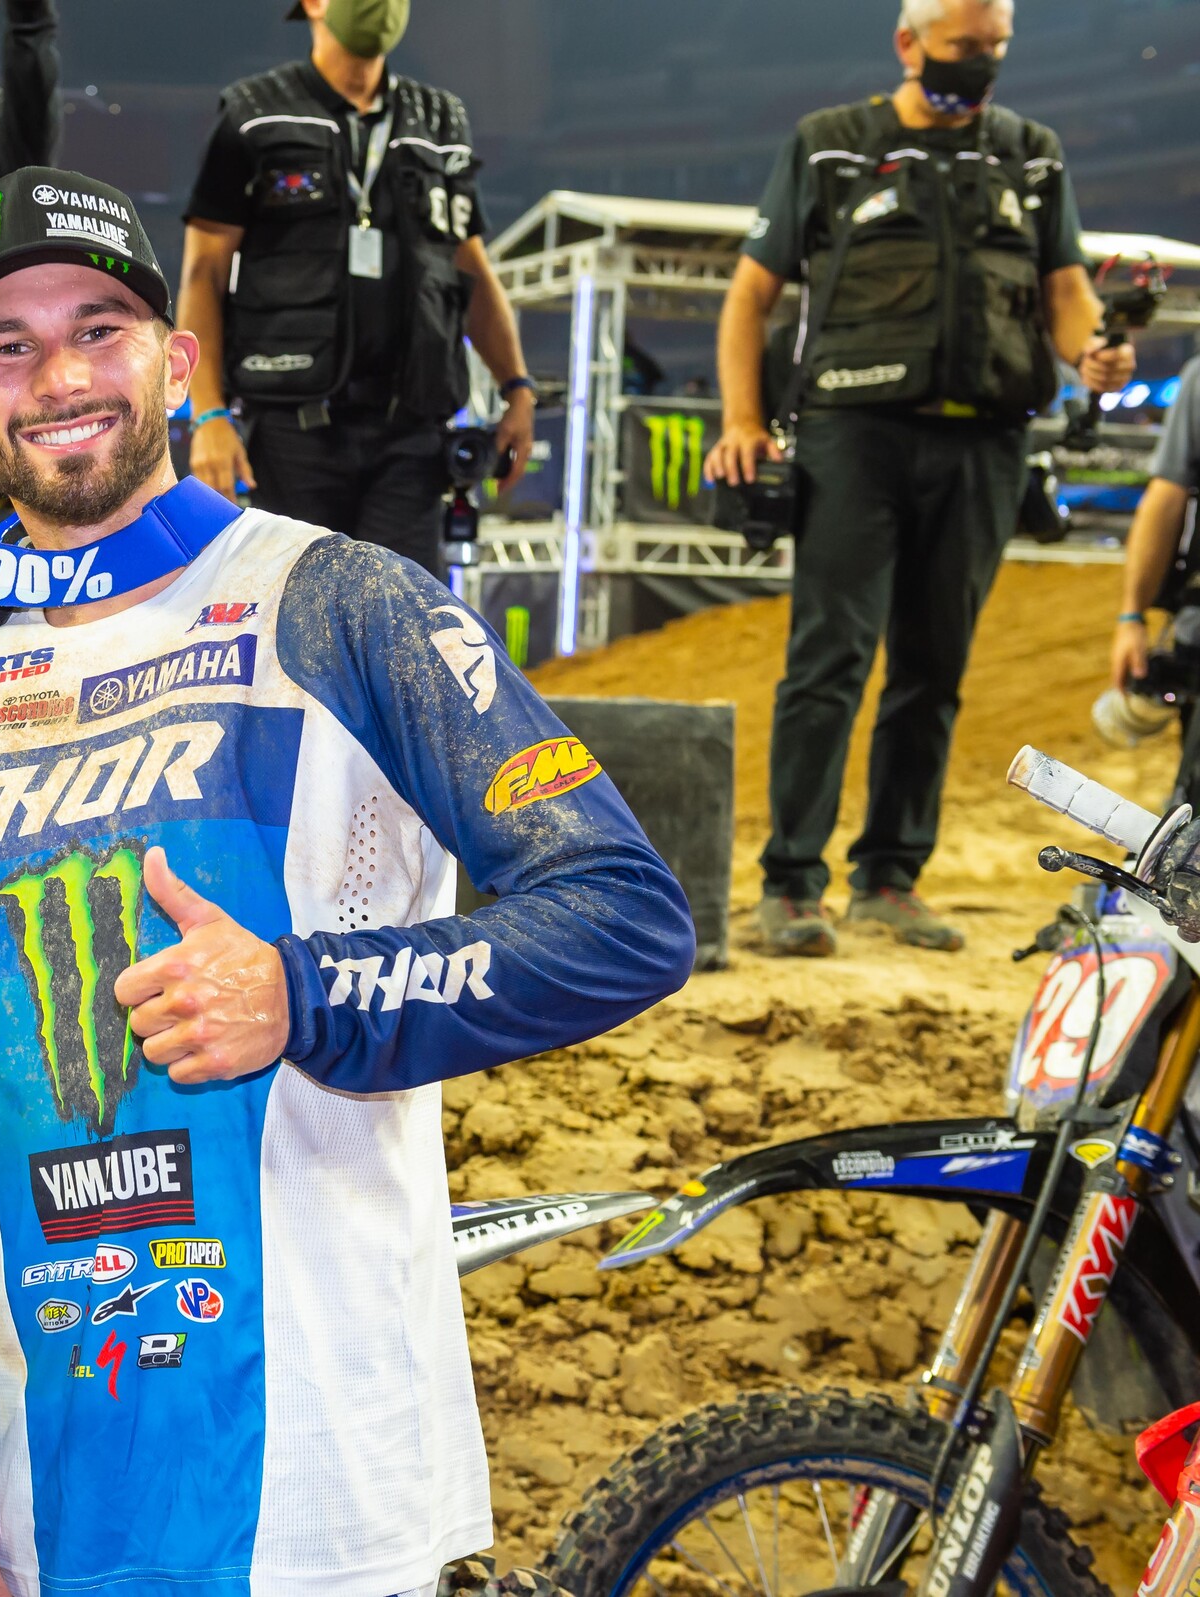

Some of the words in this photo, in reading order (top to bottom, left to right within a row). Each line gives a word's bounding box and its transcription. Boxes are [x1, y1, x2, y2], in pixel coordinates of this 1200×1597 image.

[58, 189, 131, 224] YAMAHA
[46, 212, 127, 248] YAMALUBE
[184, 602, 259, 633] AMA
[127, 643, 241, 695] YAMAHA
[19, 690, 60, 702] TOYOTA
[319, 939, 496, 1012] THOR
[1017, 956, 1158, 1085] 29
[454, 1202, 589, 1248] UNLOP
[95, 1255, 127, 1271] ELL
[156, 1241, 221, 1266] PROTAPER
[179, 1282, 210, 1319] VP
[928, 1442, 995, 1597] UNLOP
